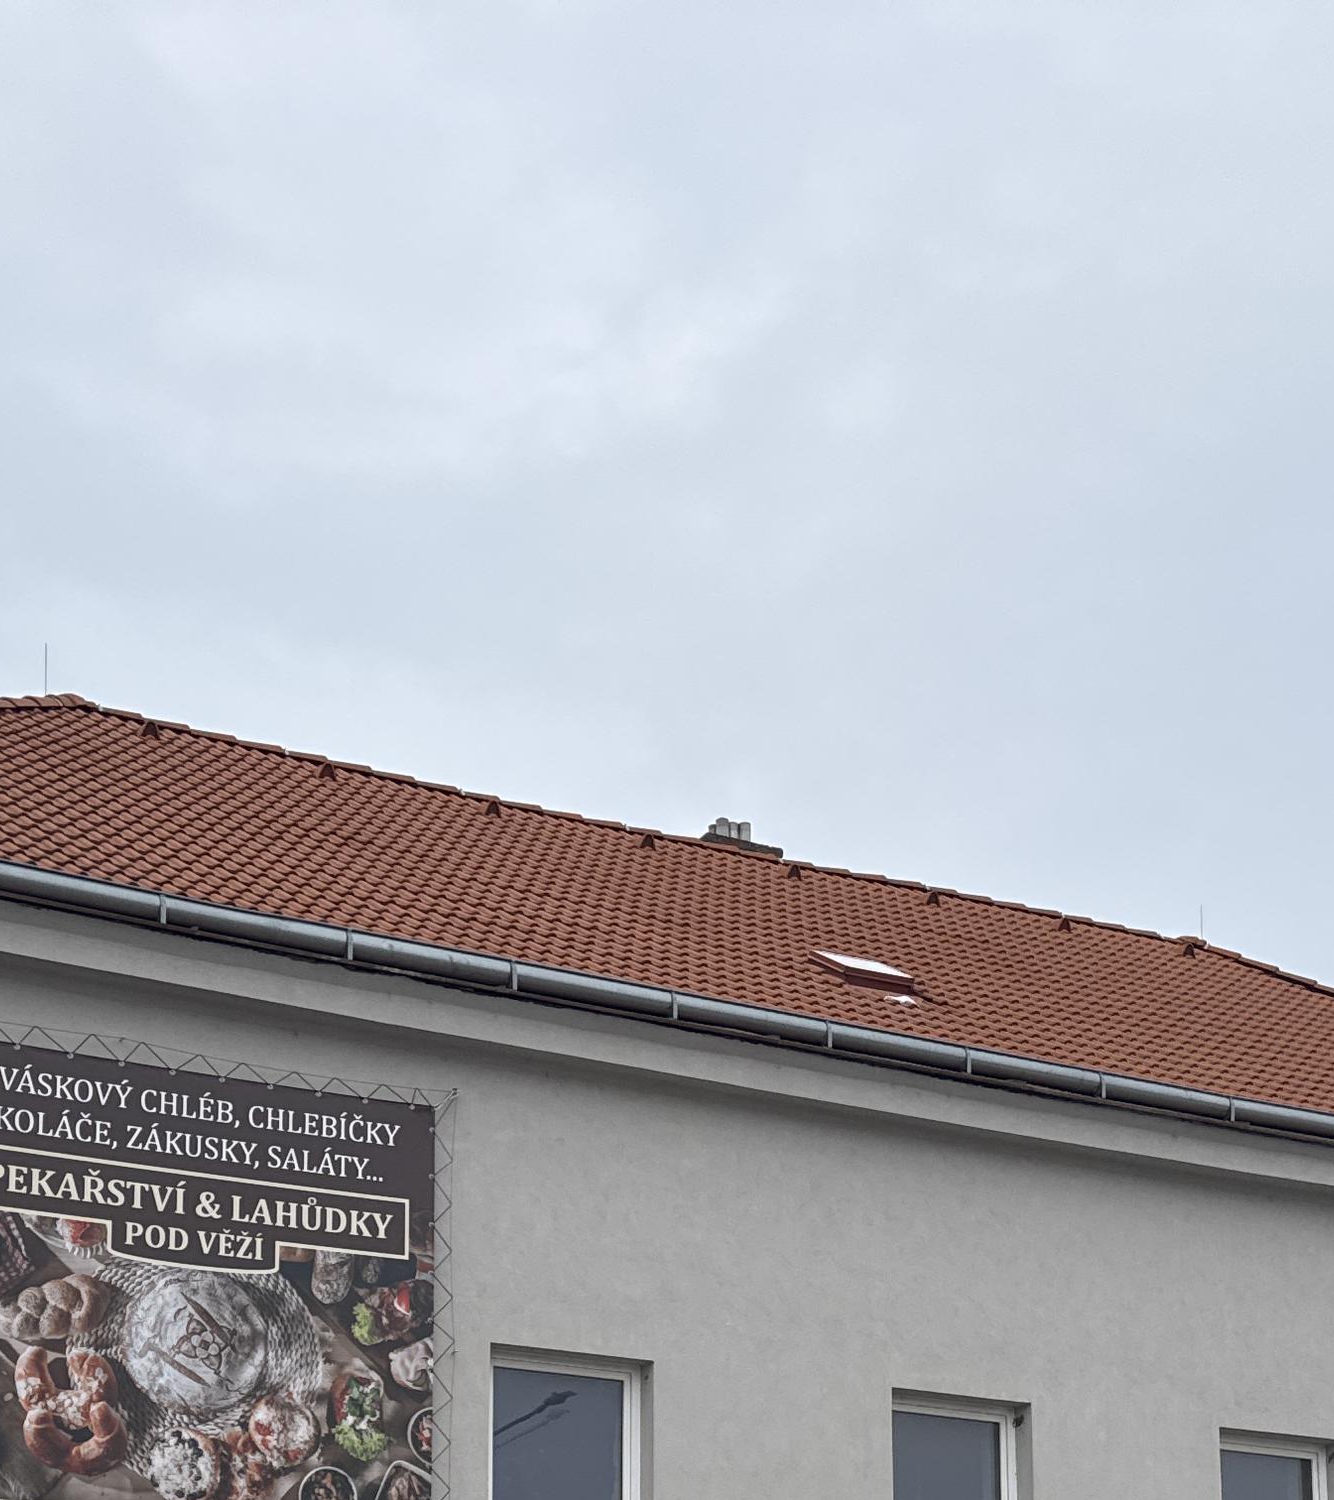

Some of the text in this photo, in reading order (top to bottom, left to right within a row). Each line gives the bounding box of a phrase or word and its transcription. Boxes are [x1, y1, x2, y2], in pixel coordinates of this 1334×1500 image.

[140, 1088, 240, 1128] CHLÉB,
[248, 1105, 401, 1147] CHLEBÍČKY
[126, 1125, 260, 1169] ZÁKUSKY,
[268, 1144, 384, 1183] SALÁTY...
[124, 1222, 265, 1261] POD VĚŽÍ
[195, 1191, 222, 1219] &
[231, 1197, 394, 1240] LAHŮDKY
